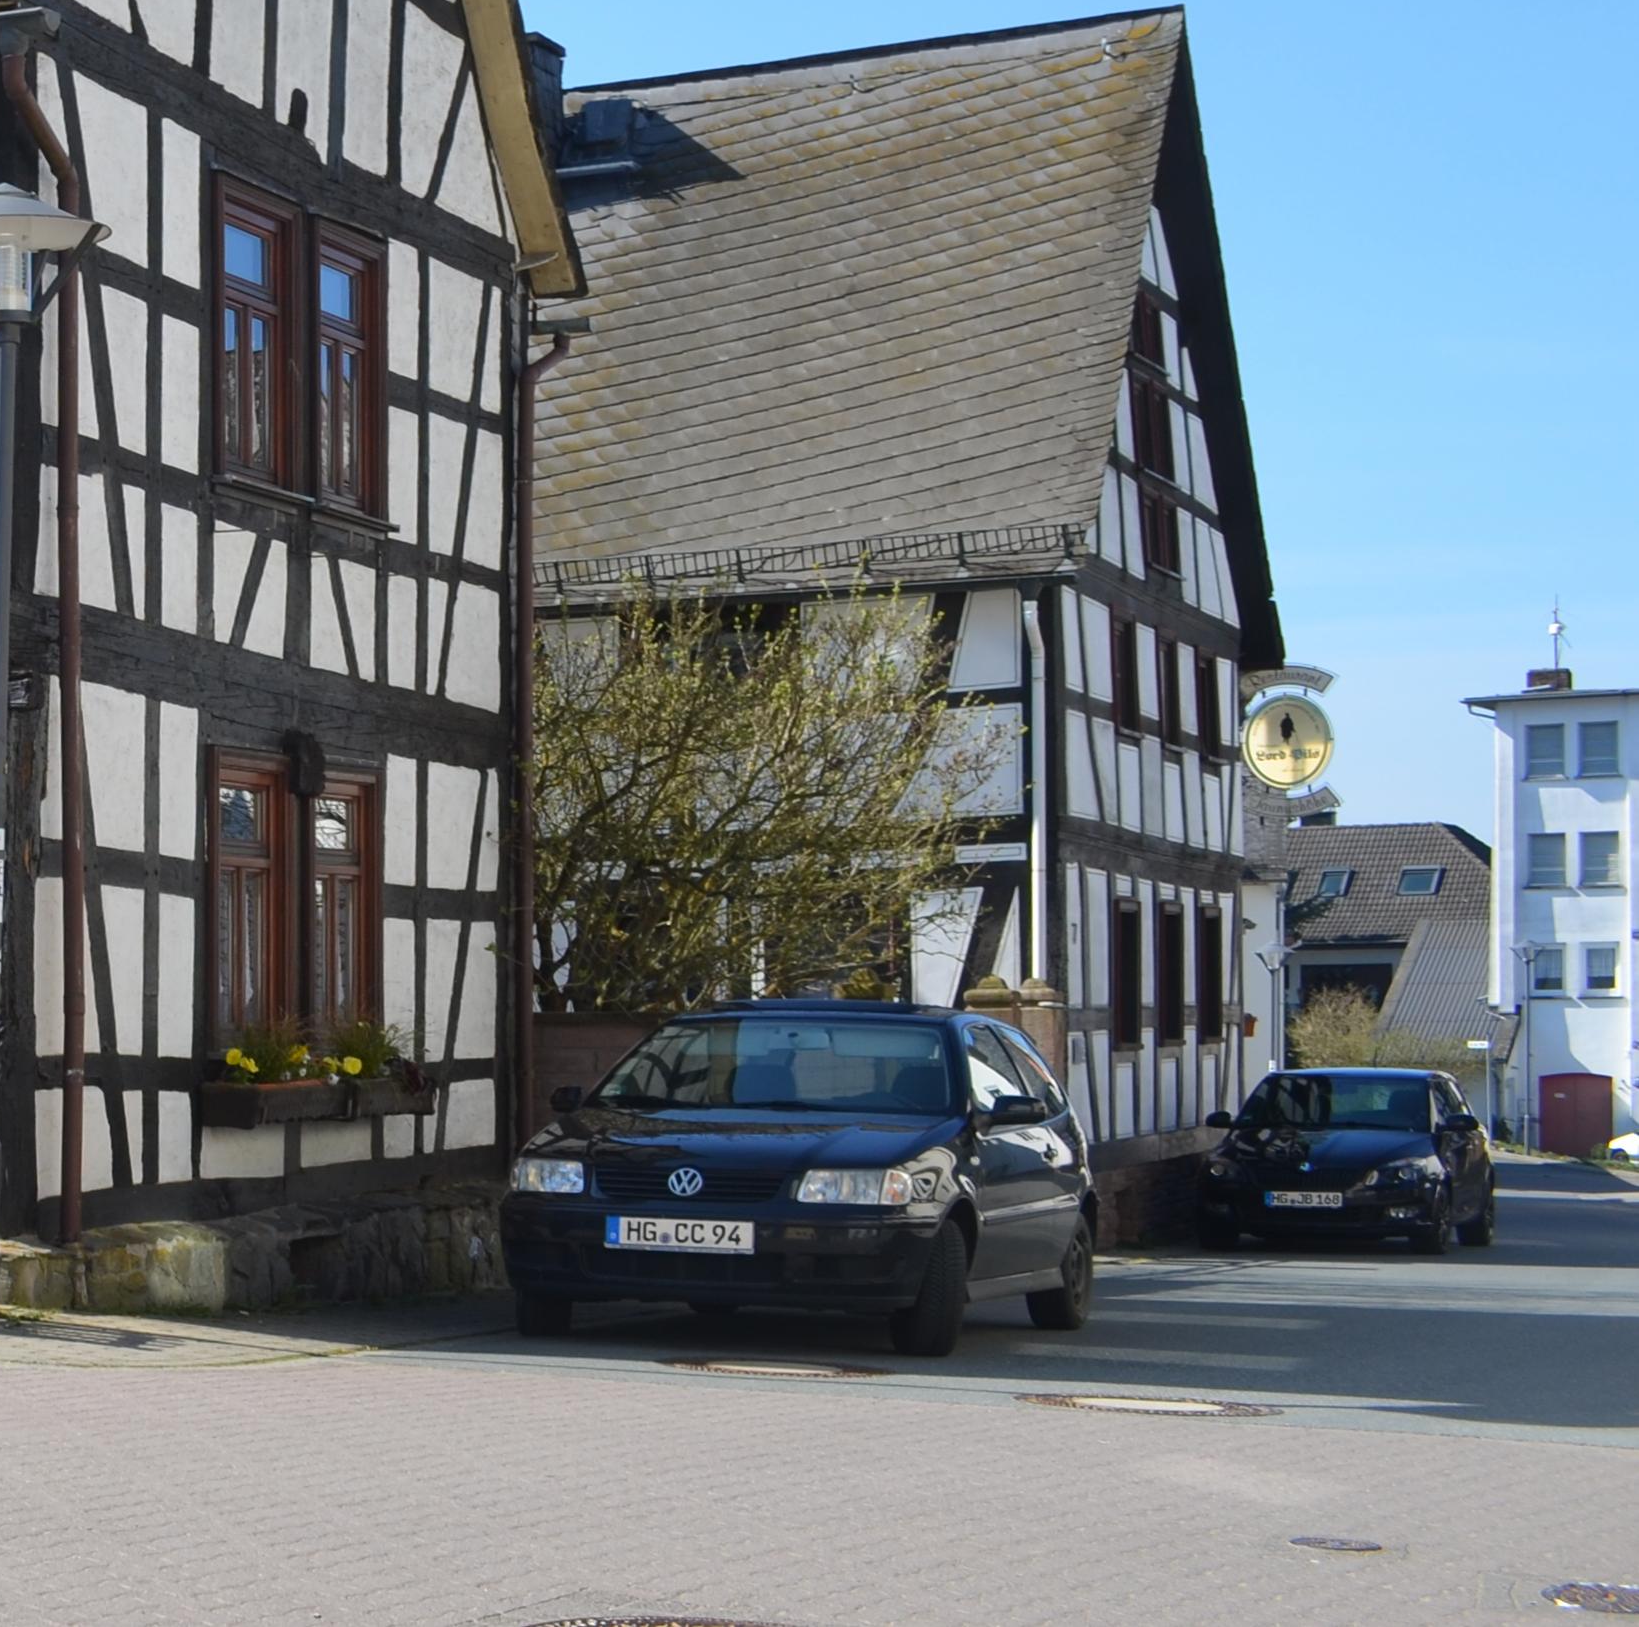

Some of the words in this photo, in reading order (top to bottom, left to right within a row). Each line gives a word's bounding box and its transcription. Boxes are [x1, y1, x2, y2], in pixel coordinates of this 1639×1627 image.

[1316, 1194, 1341, 1206] 168
[626, 1220, 657, 1243] HG
[674, 1222, 706, 1244] CC
[712, 1224, 742, 1246] 94
